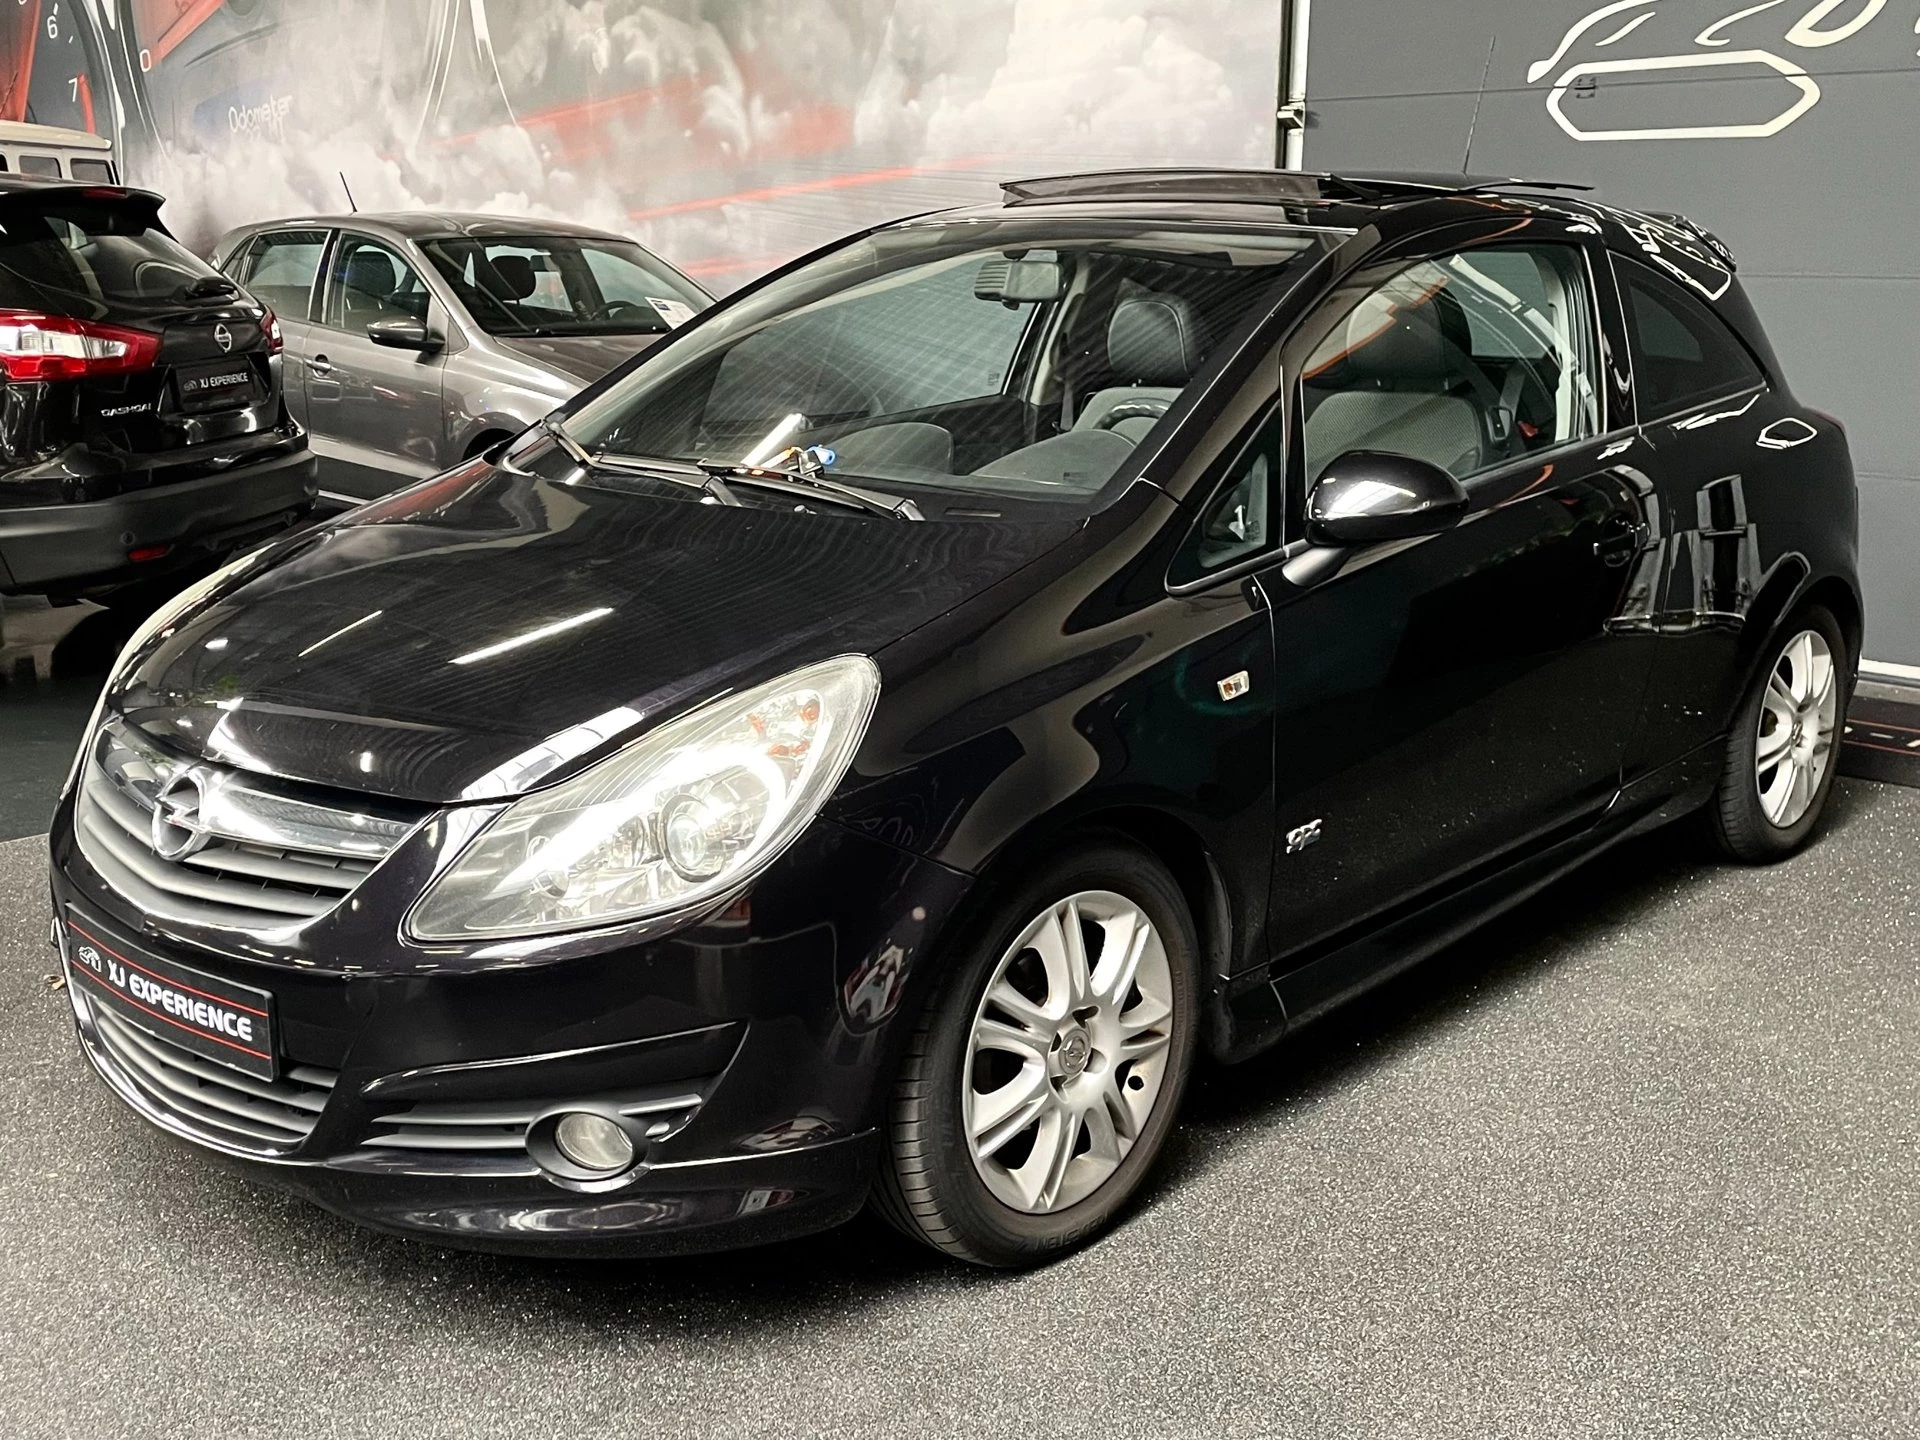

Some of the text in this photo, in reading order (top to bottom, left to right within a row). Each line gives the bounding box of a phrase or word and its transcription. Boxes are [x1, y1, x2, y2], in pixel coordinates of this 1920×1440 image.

[46, 15, 59, 39] 6
[68, 77, 79, 103] 7
[209, 372, 249, 387] EXPERIENCE
[107, 959, 253, 1042] XJ EXPERIENCE
